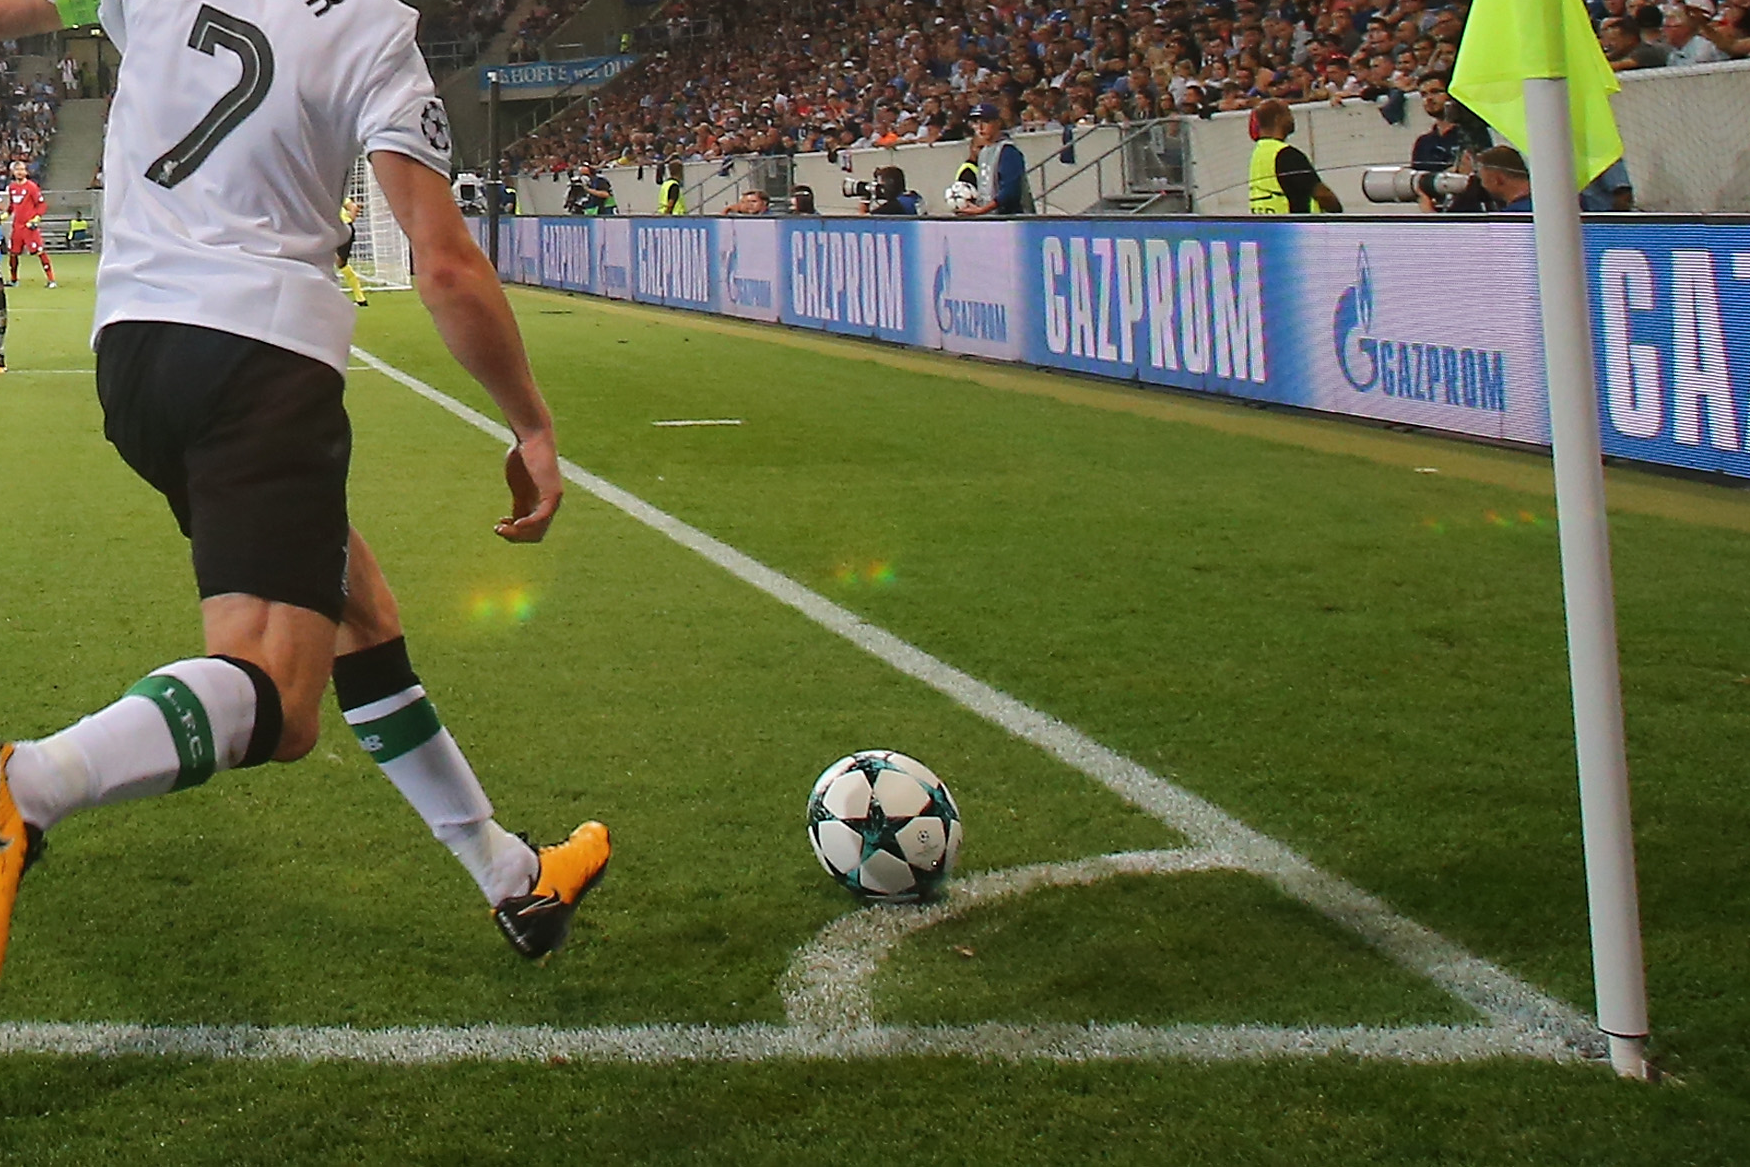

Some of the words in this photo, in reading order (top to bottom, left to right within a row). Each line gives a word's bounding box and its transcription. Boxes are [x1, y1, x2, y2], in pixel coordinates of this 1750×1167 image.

[145, 3, 275, 189] 7
[638, 227, 709, 302] GAZPROM
[791, 231, 905, 331] GAZPROM
[1042, 236, 1267, 383] GAZPROM
[1380, 340, 1506, 413] GAZPROM
[1599, 249, 1750, 453] GA
